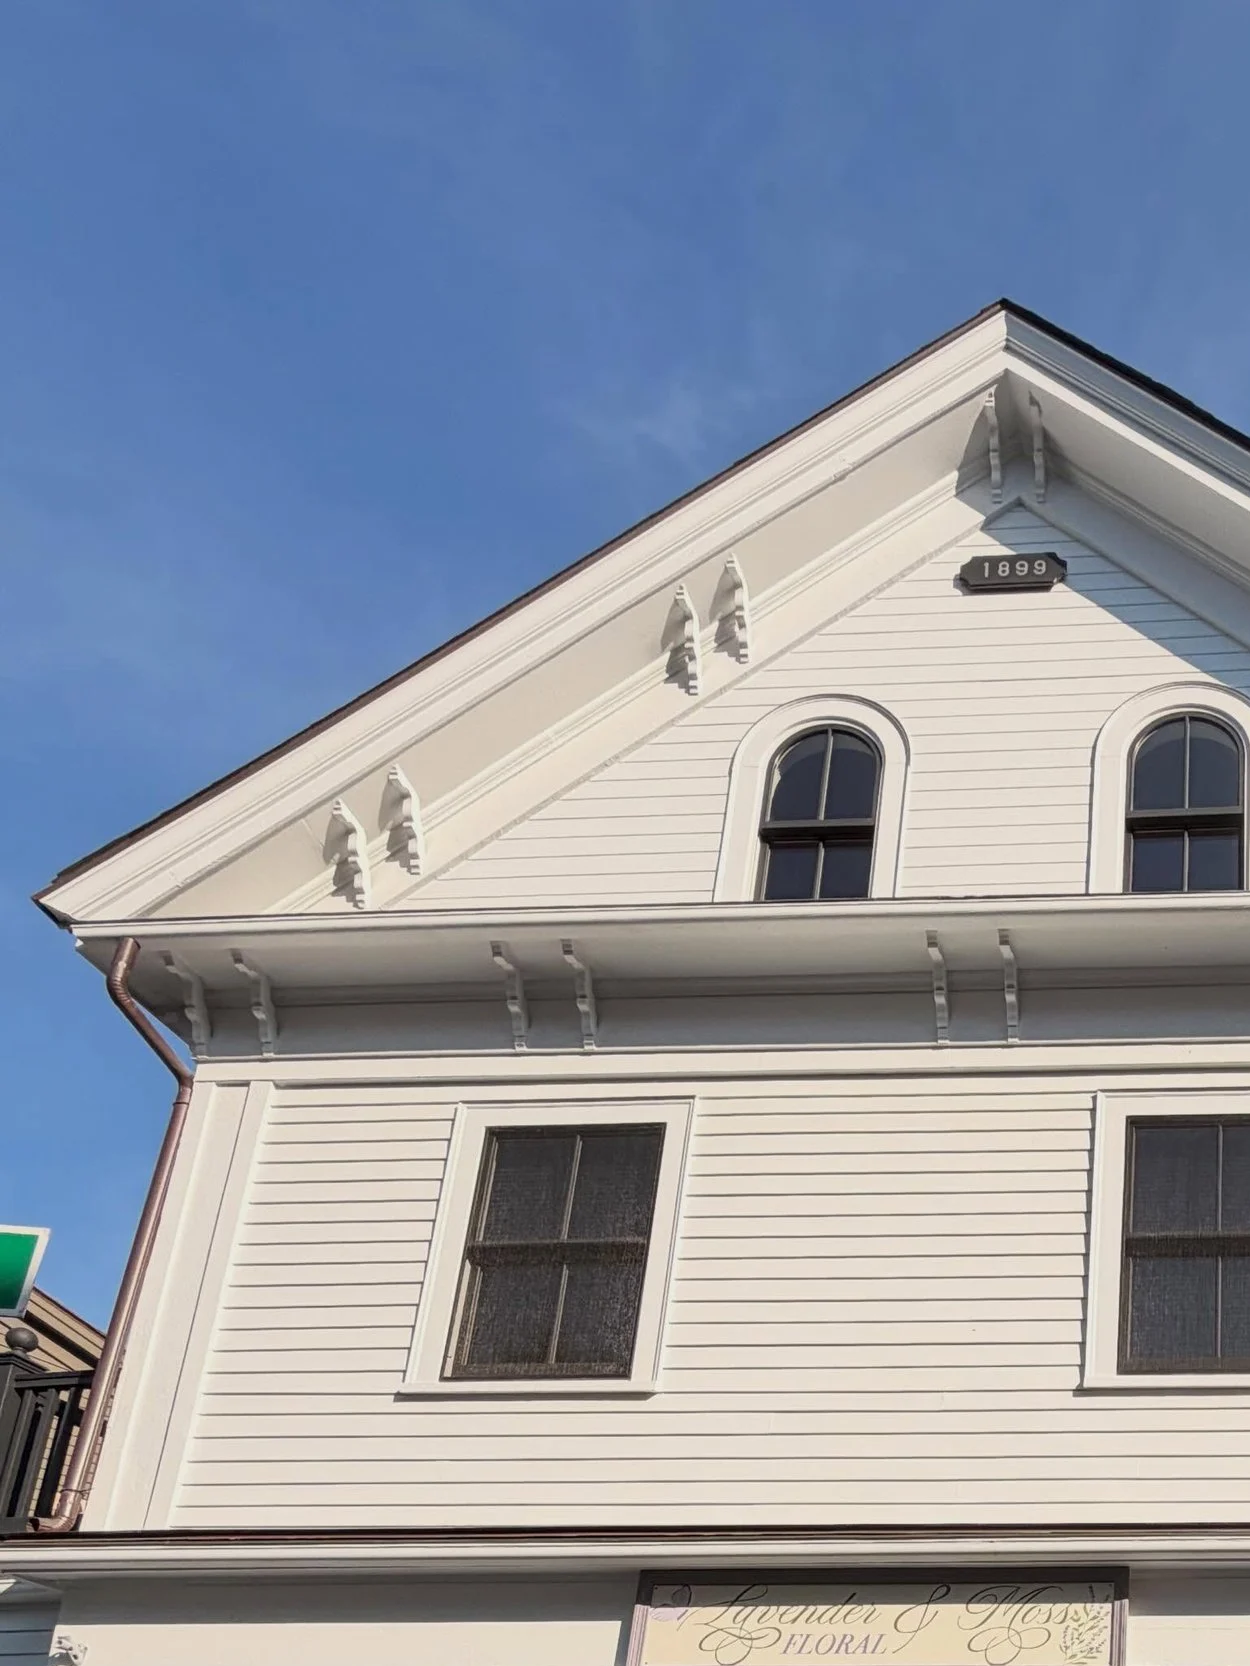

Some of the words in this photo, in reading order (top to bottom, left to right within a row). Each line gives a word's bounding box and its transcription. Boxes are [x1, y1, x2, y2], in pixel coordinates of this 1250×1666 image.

[984, 560, 1046, 578] 1899
[694, 1584, 880, 1652] Lavender
[893, 1584, 950, 1653] &
[957, 1585, 1073, 1652] Moss
[782, 1633, 887, 1655] FLORAL
